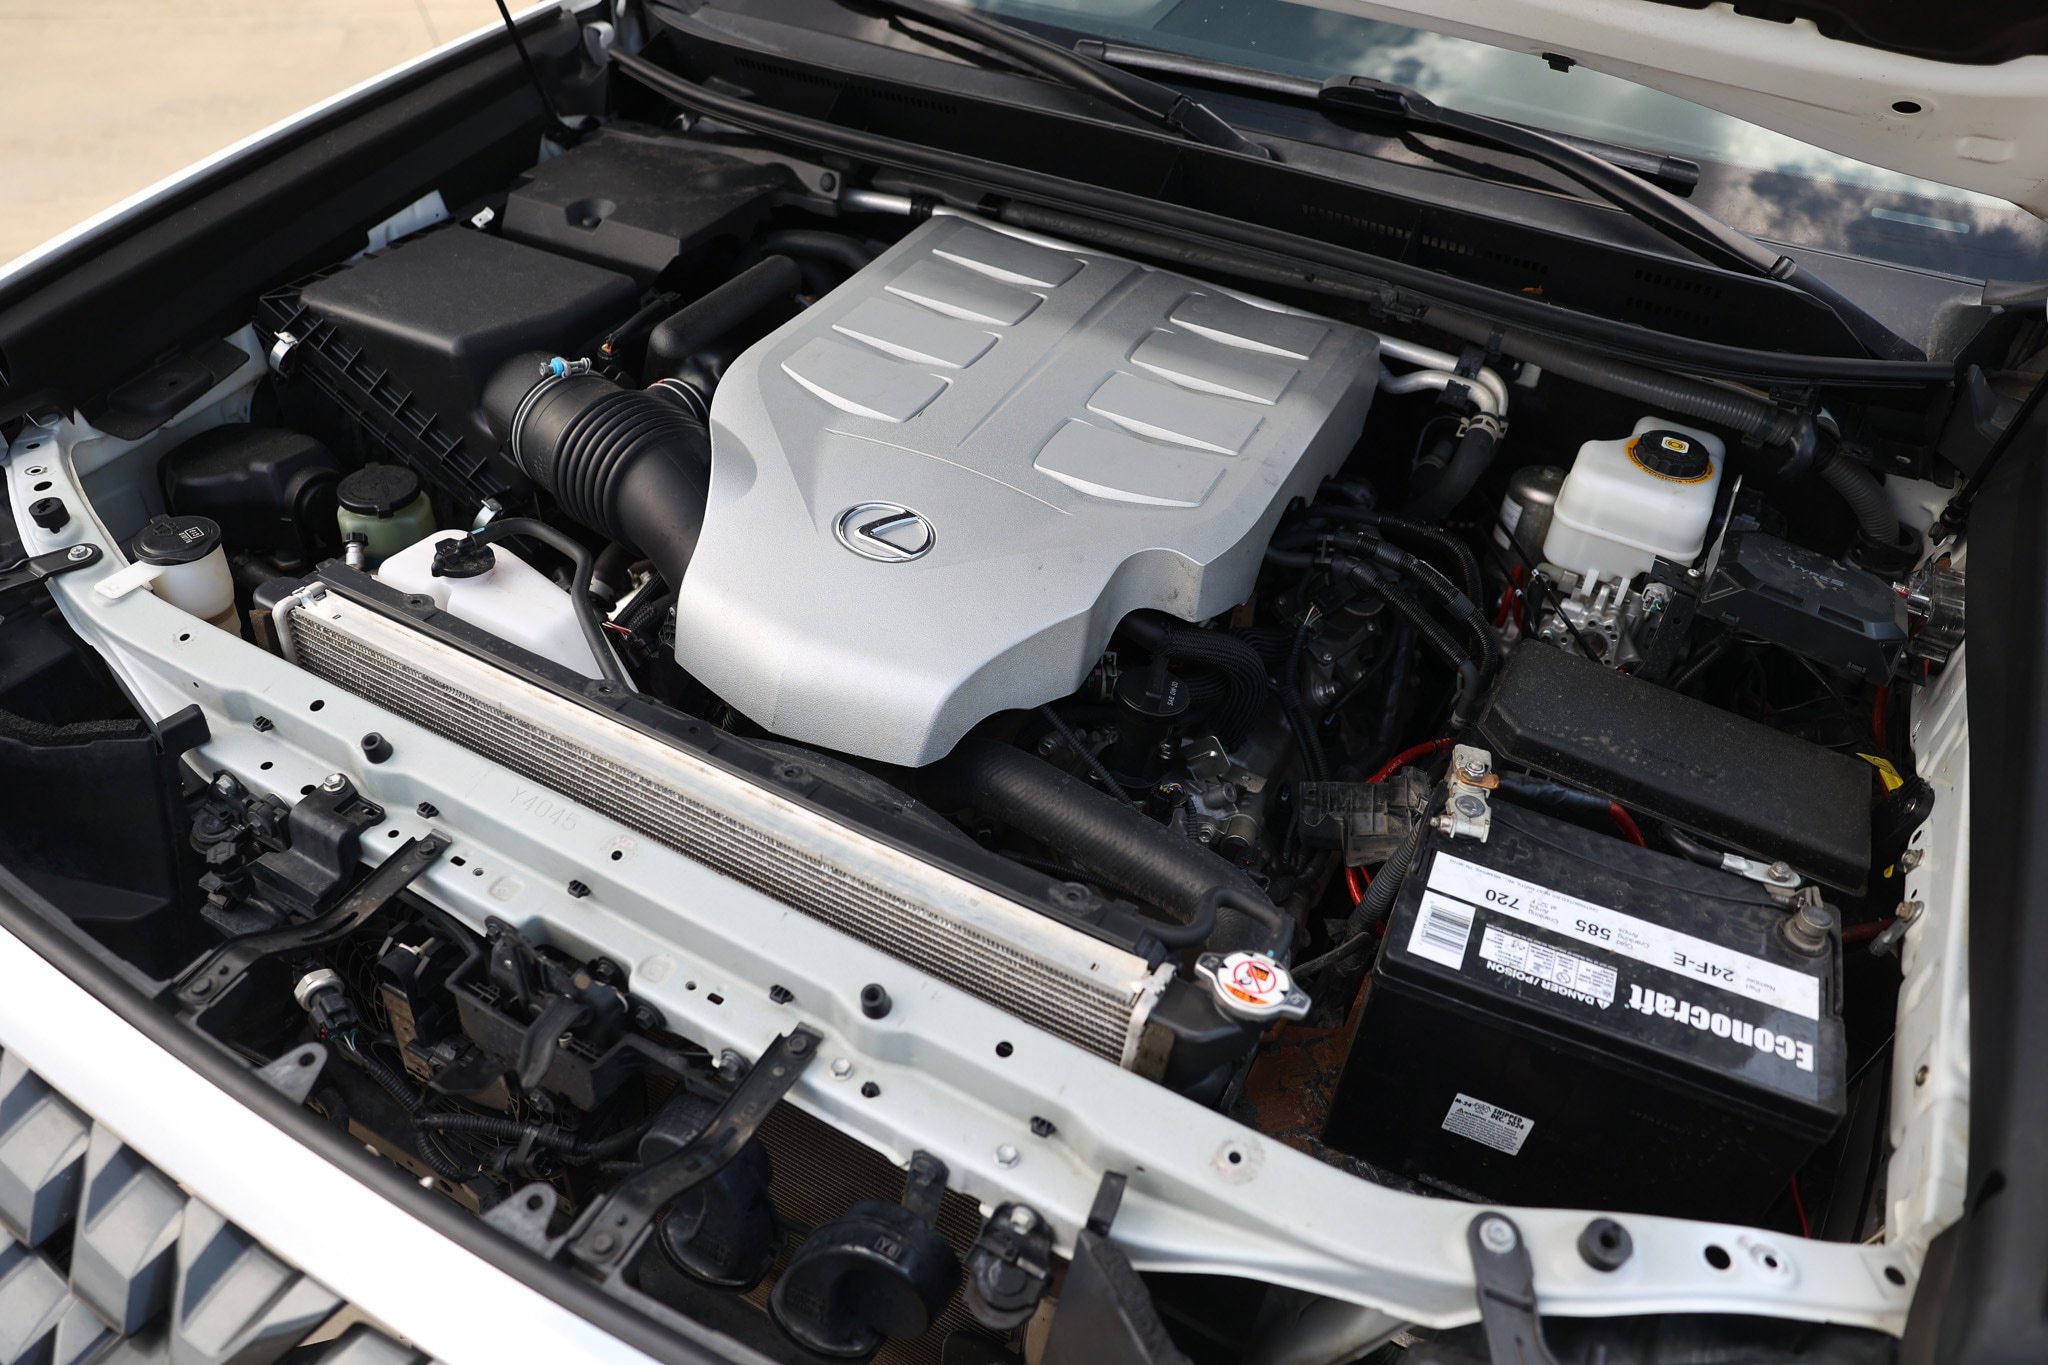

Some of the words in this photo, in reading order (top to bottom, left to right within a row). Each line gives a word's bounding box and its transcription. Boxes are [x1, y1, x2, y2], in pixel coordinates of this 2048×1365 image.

[1166, 696, 1174, 706] SAE
[510, 784, 580, 831] Y4045
[1486, 889, 1520, 910] 720
[1576, 919, 1611, 940] 585
[1673, 952, 1735, 982] 24F-E
[1541, 981, 1594, 1006] DANGER
[1630, 984, 1814, 1072] Econocraft
[1494, 1108, 1522, 1122] SHIPPED
